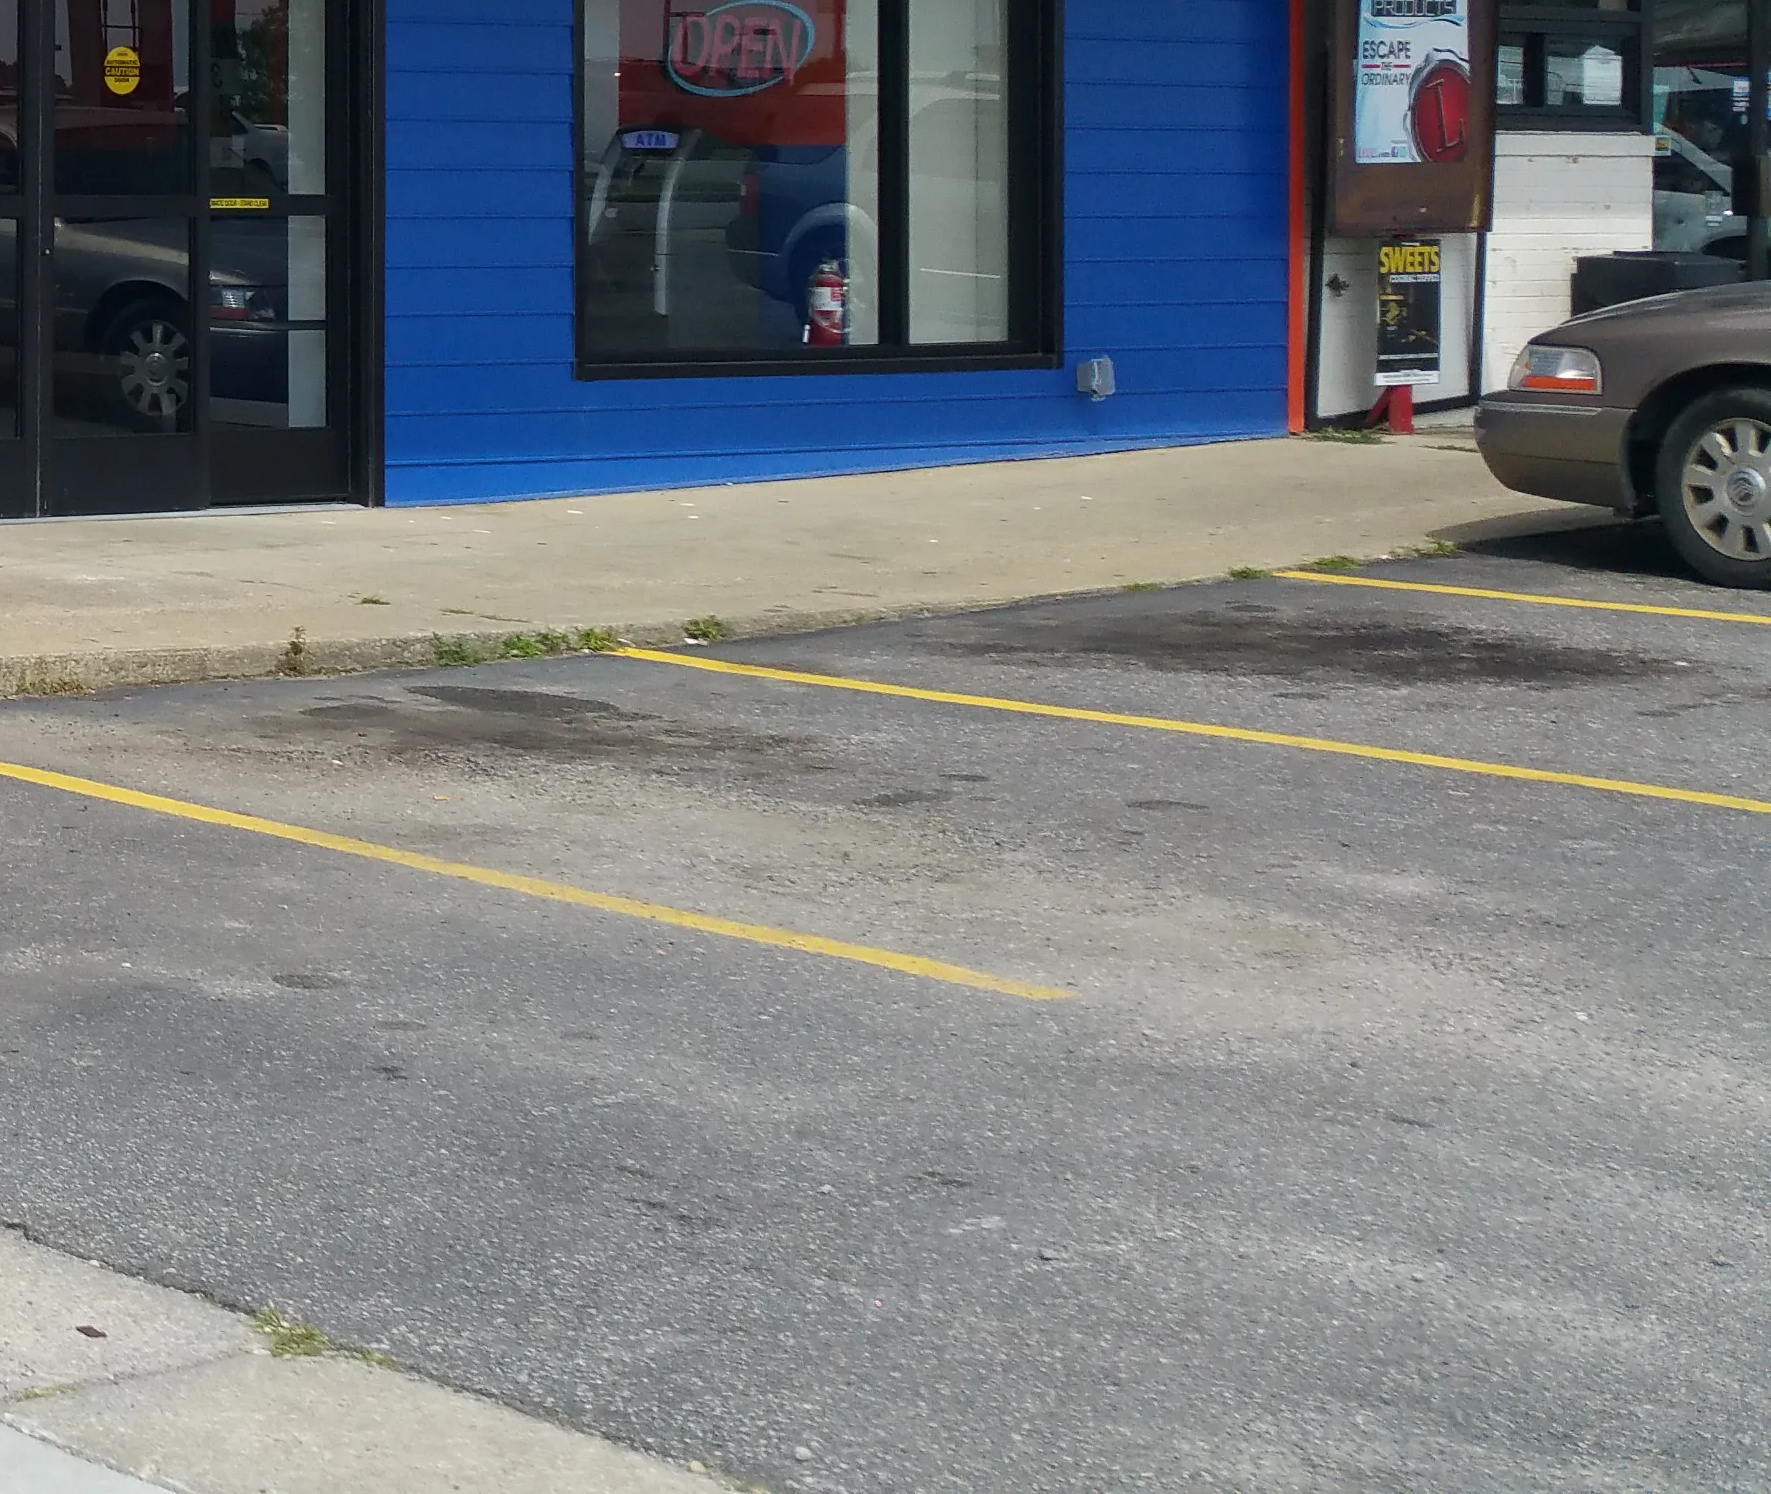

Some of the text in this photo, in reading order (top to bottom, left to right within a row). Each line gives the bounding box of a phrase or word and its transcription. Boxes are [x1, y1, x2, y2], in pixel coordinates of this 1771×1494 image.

[672, 14, 802, 85] OPEN
[1362, 39, 1411, 60] ESCAPE
[105, 67, 140, 76] CAUTION
[1361, 72, 1412, 86] ORDINARY
[635, 133, 667, 148] ATM
[1379, 246, 1440, 274] SWEETS
